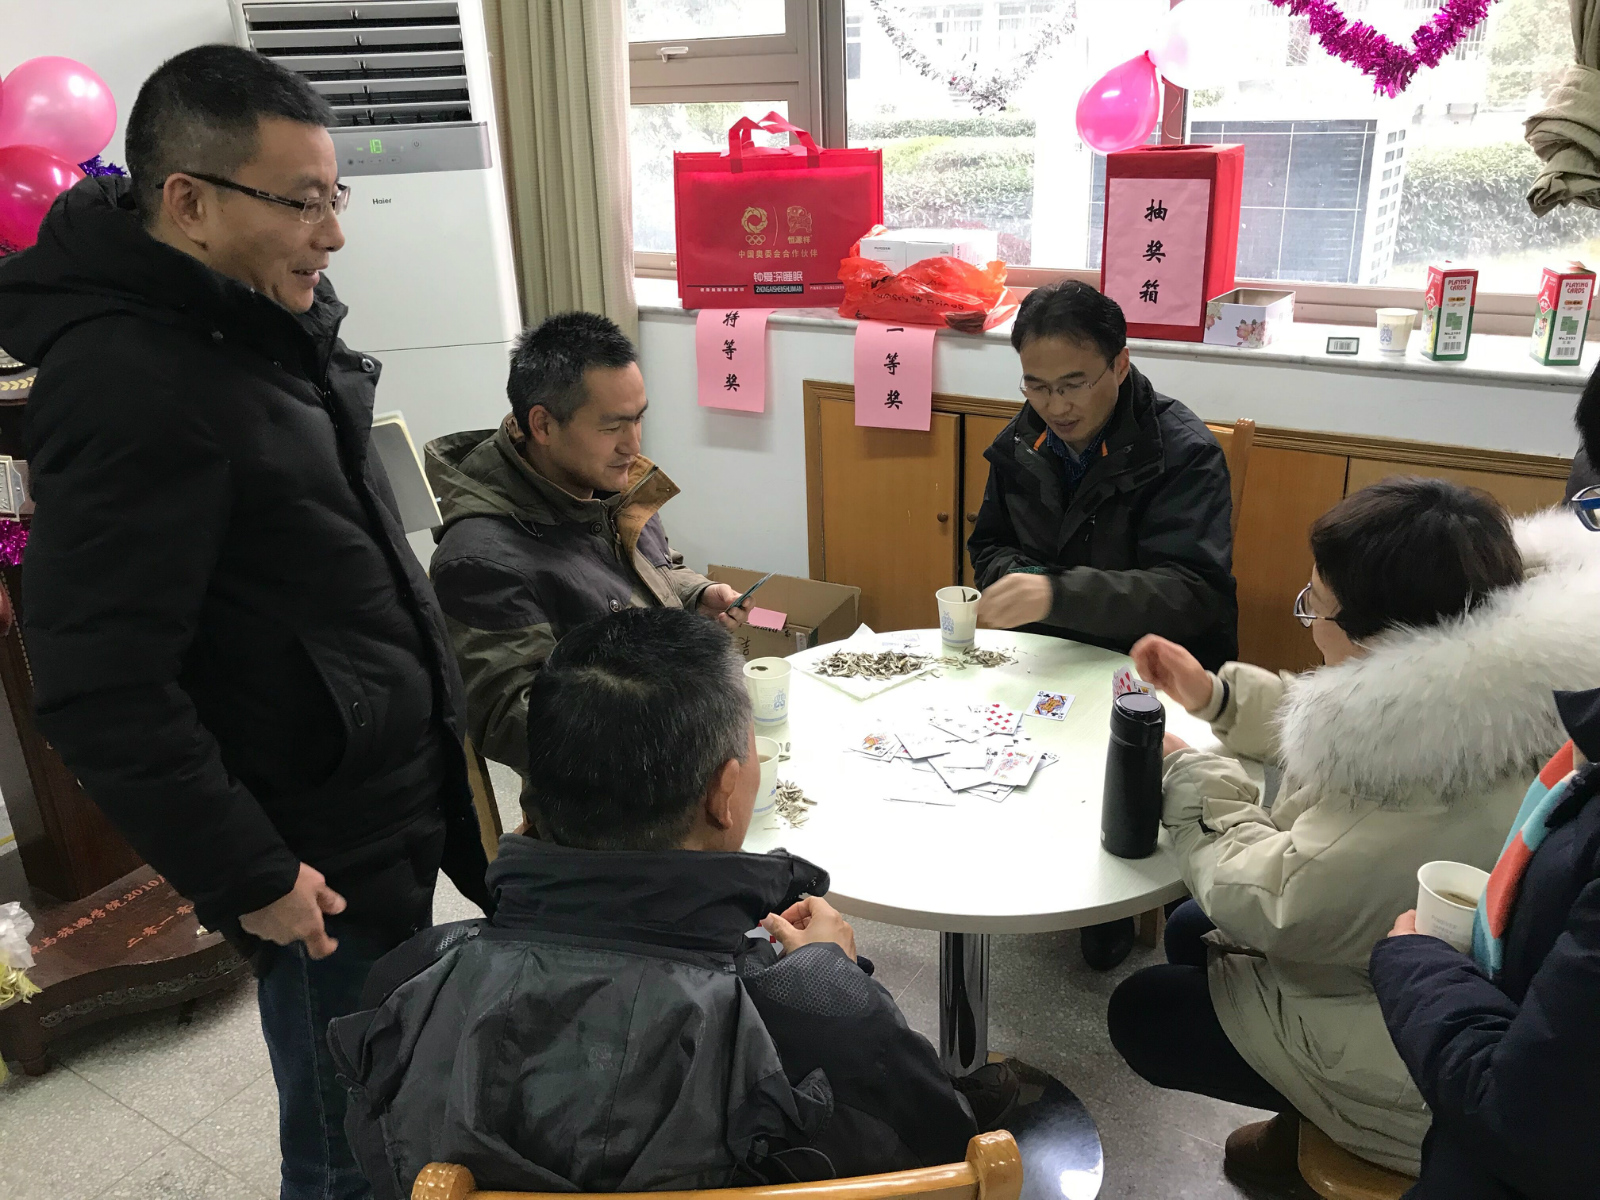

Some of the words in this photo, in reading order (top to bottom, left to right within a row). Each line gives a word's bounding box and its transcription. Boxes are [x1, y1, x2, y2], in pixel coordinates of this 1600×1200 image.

[753, 270, 804, 283] 钟爱深睡眠
[787, 235, 811, 244] 恒源祥
[1139, 199, 1168, 304] 抽奖箱
[722, 310, 741, 393] 特等奖
[883, 327, 905, 410] 一等奖
